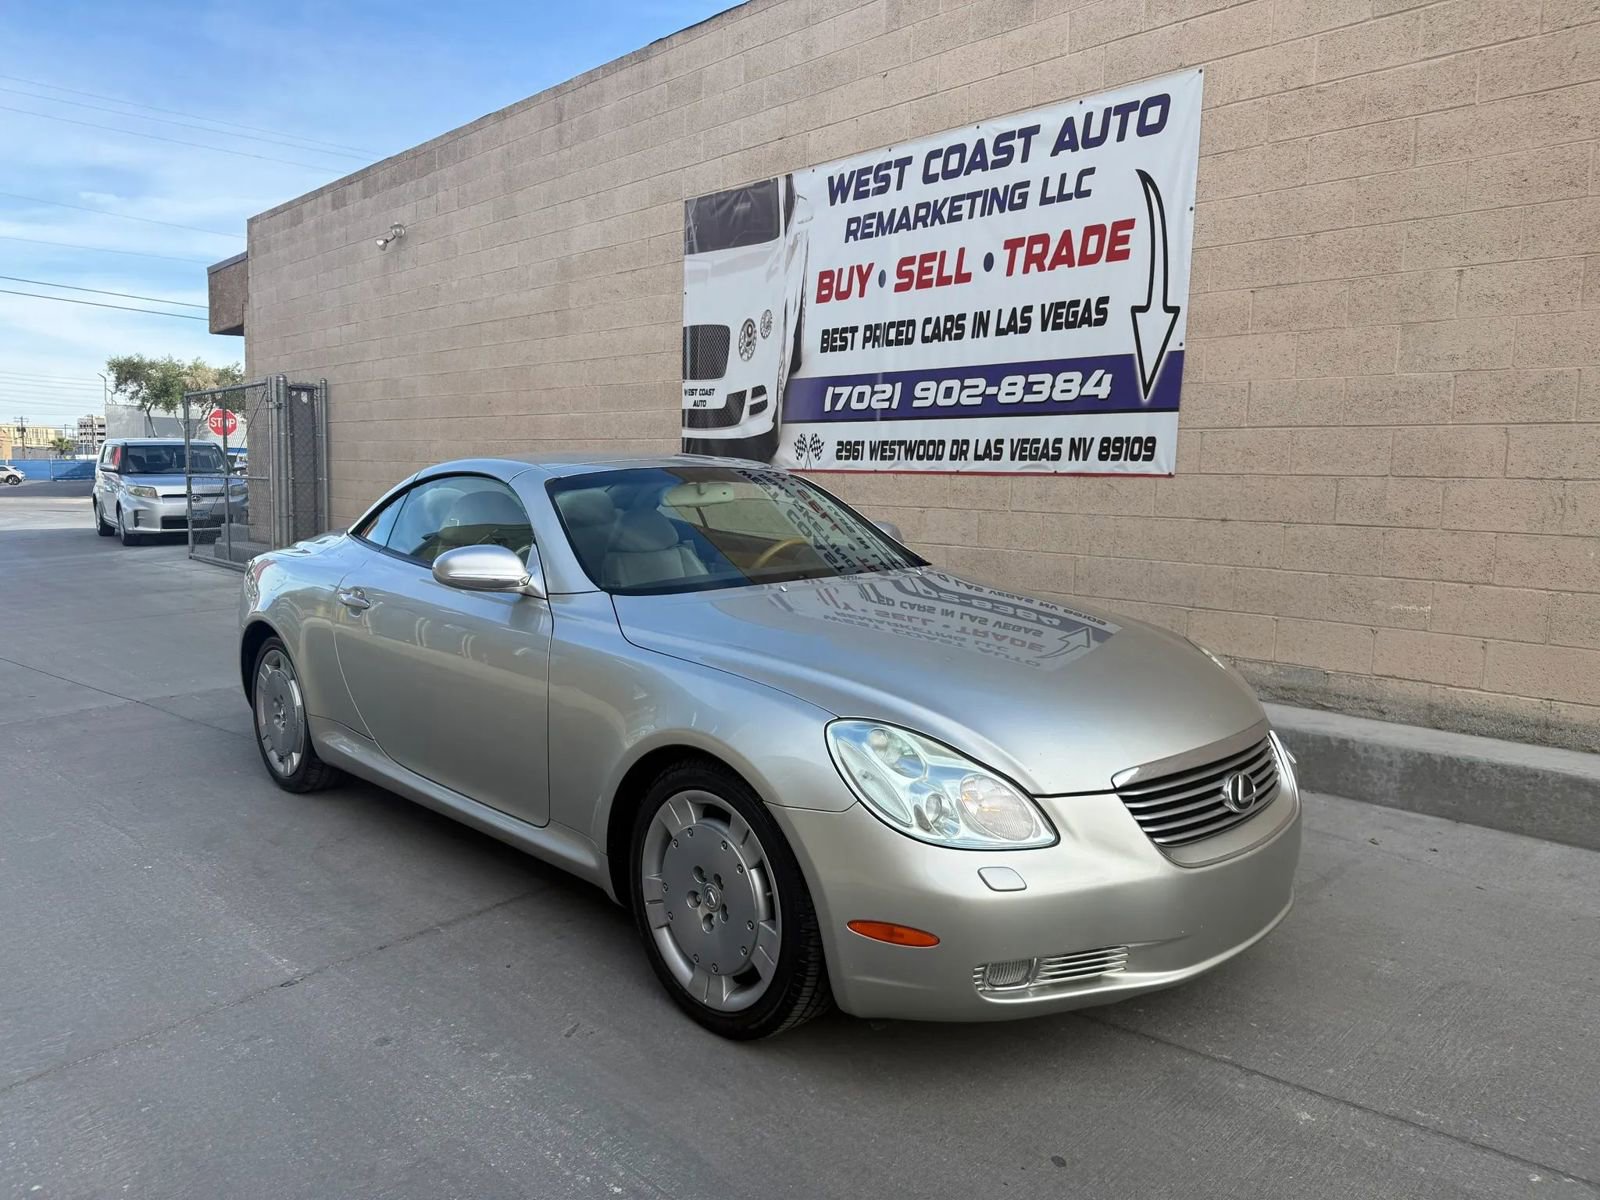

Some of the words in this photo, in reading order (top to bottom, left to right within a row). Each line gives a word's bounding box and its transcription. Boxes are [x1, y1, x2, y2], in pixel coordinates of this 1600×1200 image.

[827, 156, 914, 206] WEST
[922, 124, 1041, 185] COAST
[1050, 93, 1171, 157] AUTO
[844, 180, 1031, 244] REMARKETING
[1038, 166, 1097, 207] LLC
[815, 262, 875, 304] BUY
[894, 247, 972, 293] SELL
[1003, 218, 1136, 277] TRADE
[820, 325, 859, 354] BEST
[862, 319, 916, 350] PRICED
[921, 313, 967, 344] CARS
[971, 310, 991, 339] IN
[995, 305, 1033, 337] LAS
[1040, 296, 1110, 332] VEGAS
[684, 388, 698, 396] WEST
[699, 388, 715, 396] COAST
[912, 369, 1113, 408] 902-8384
[835, 439, 864, 461] 2961
[868, 438, 946, 461] WESTWOOD
[949, 439, 969, 461] DR
[973, 438, 1004, 461] LAS
[1009, 437, 1062, 462] VEGAS
[1068, 437, 1093, 462] NV
[1097, 436, 1156, 462] 89109
